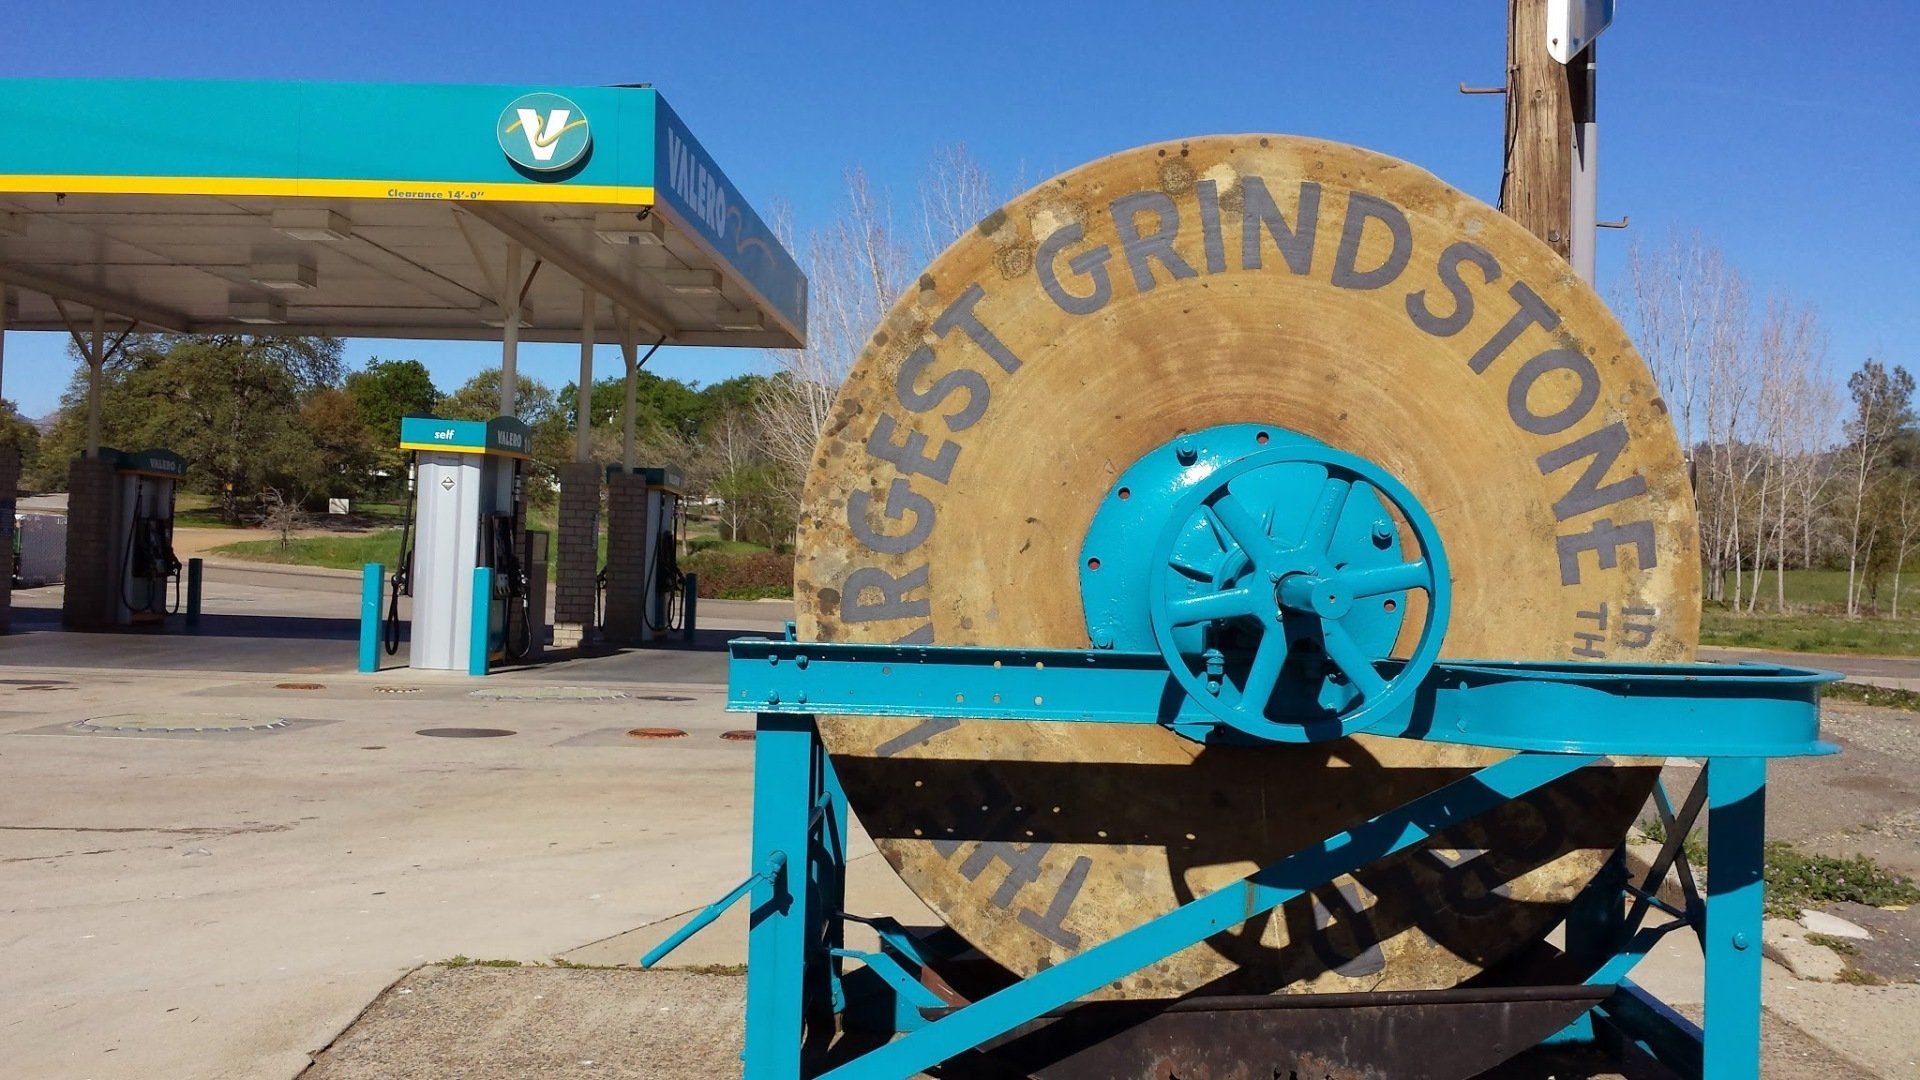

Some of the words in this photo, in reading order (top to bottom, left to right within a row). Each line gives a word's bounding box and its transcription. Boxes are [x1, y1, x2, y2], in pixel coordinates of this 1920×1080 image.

[516, 107, 571, 160] V
[388, 189, 443, 199] Clearance
[668, 126, 727, 239] VALERO
[434, 428, 455, 441] self
[497, 430, 522, 448] VALERO
[150, 458, 176, 471] VALERO
[840, 282, 1023, 758] LRGEST
[1035, 175, 1657, 586] GRINDSTONE
[1571, 602, 1608, 660] TH
